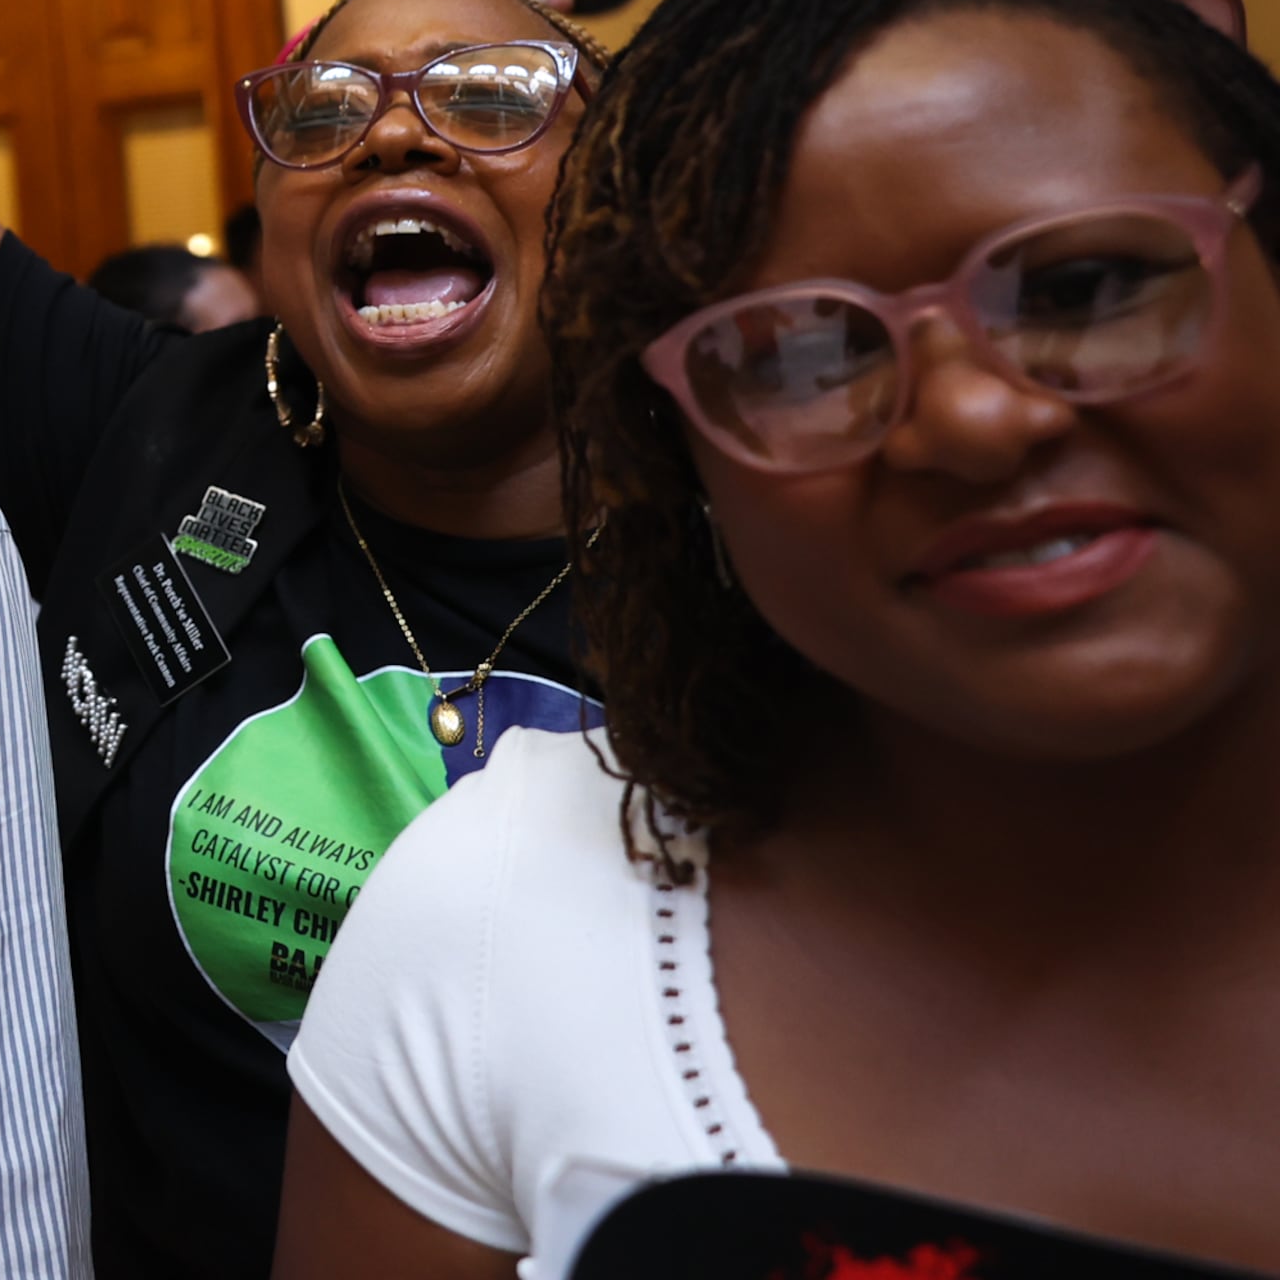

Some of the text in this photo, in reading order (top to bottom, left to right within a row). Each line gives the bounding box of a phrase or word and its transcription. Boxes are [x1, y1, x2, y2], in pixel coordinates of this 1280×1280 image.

[182, 520, 253, 556] MATTER
[200, 506, 252, 536] LIVES
[207, 490, 262, 520] BLACK
[114, 574, 176, 688] Representative Park Cannon
[132, 564, 192, 672] Chief of Community Affairs
[152, 562, 204, 650] Dr. Porch'se Miller
[188, 789, 374, 871] I AM AND ALWAYS
[191, 828, 296, 885] CATALYST
[296, 867, 340, 905] FOR
[178, 871, 286, 927] -SHIRLEY
